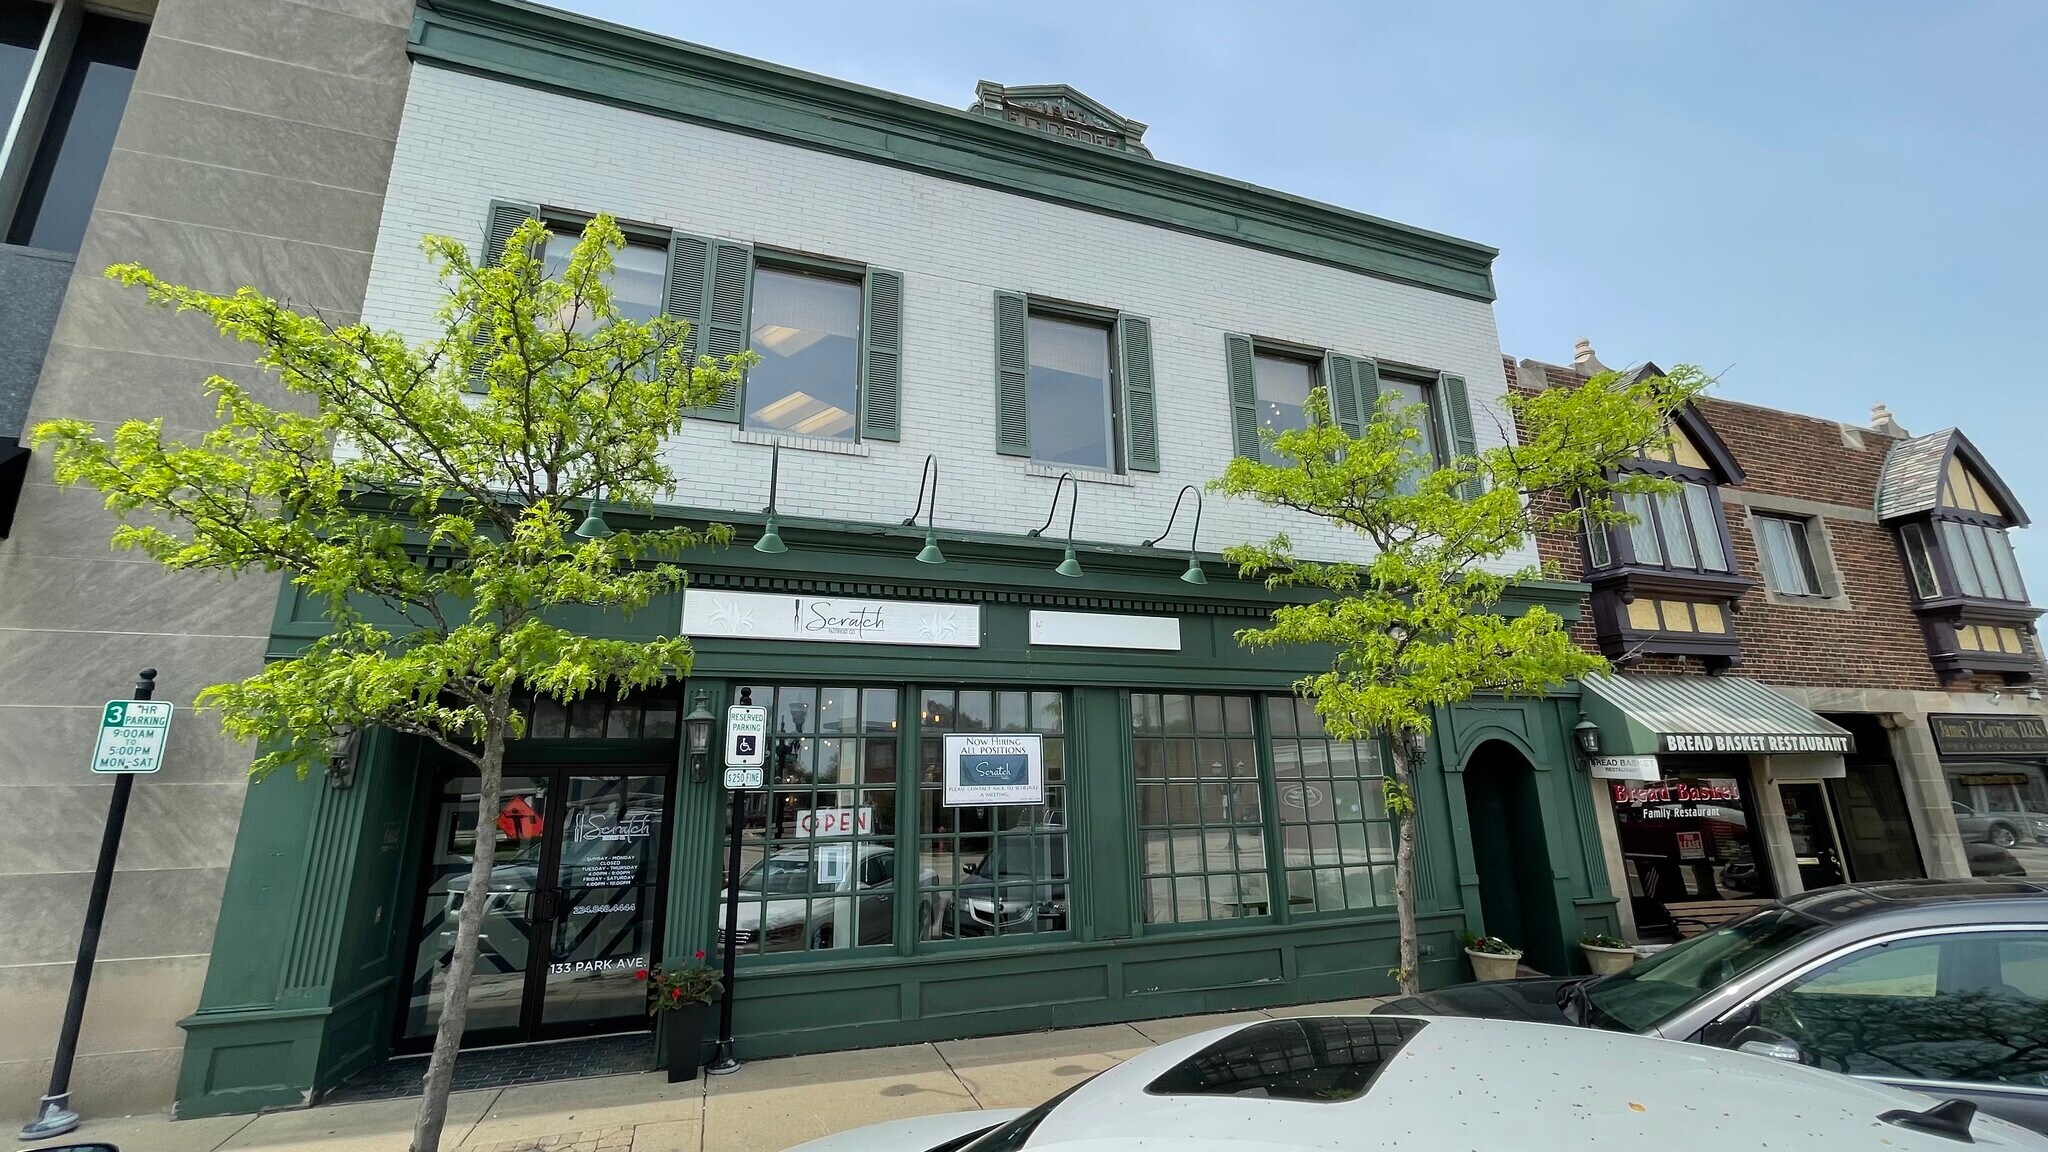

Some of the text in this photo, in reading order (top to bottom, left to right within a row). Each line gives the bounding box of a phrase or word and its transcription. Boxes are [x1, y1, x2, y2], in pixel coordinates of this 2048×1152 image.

[1043, 101, 1088, 123] 1907
[806, 602, 885, 639] Scratch
[107, 705, 124, 724] 3
[141, 705, 158, 715] HR
[125, 716, 166, 726] PARKING
[731, 713, 764, 722] RESERVED
[732, 723, 761, 732] PARKING
[113, 729, 155, 738] 9:00AM
[991, 737, 1022, 746] HIRING
[1666, 735, 1849, 752] BREAD BASKET RESTAURANT
[109, 746, 151, 756] 5:00PM
[960, 746, 1027, 755] ALL POSITIONS
[975, 761, 1012, 777] Scratch
[1621, 759, 1657, 768] BASKET
[728, 772, 760, 783] $250 FINE
[1613, 782, 1741, 803] Bread Basket
[1642, 806, 1720, 820] Family Restaurant
[801, 812, 866, 832] OPEN
[583, 814, 651, 844] Scratch
[1679, 839, 1701, 850] LEASE
[550, 957, 647, 974] 133 PARK AVE.
